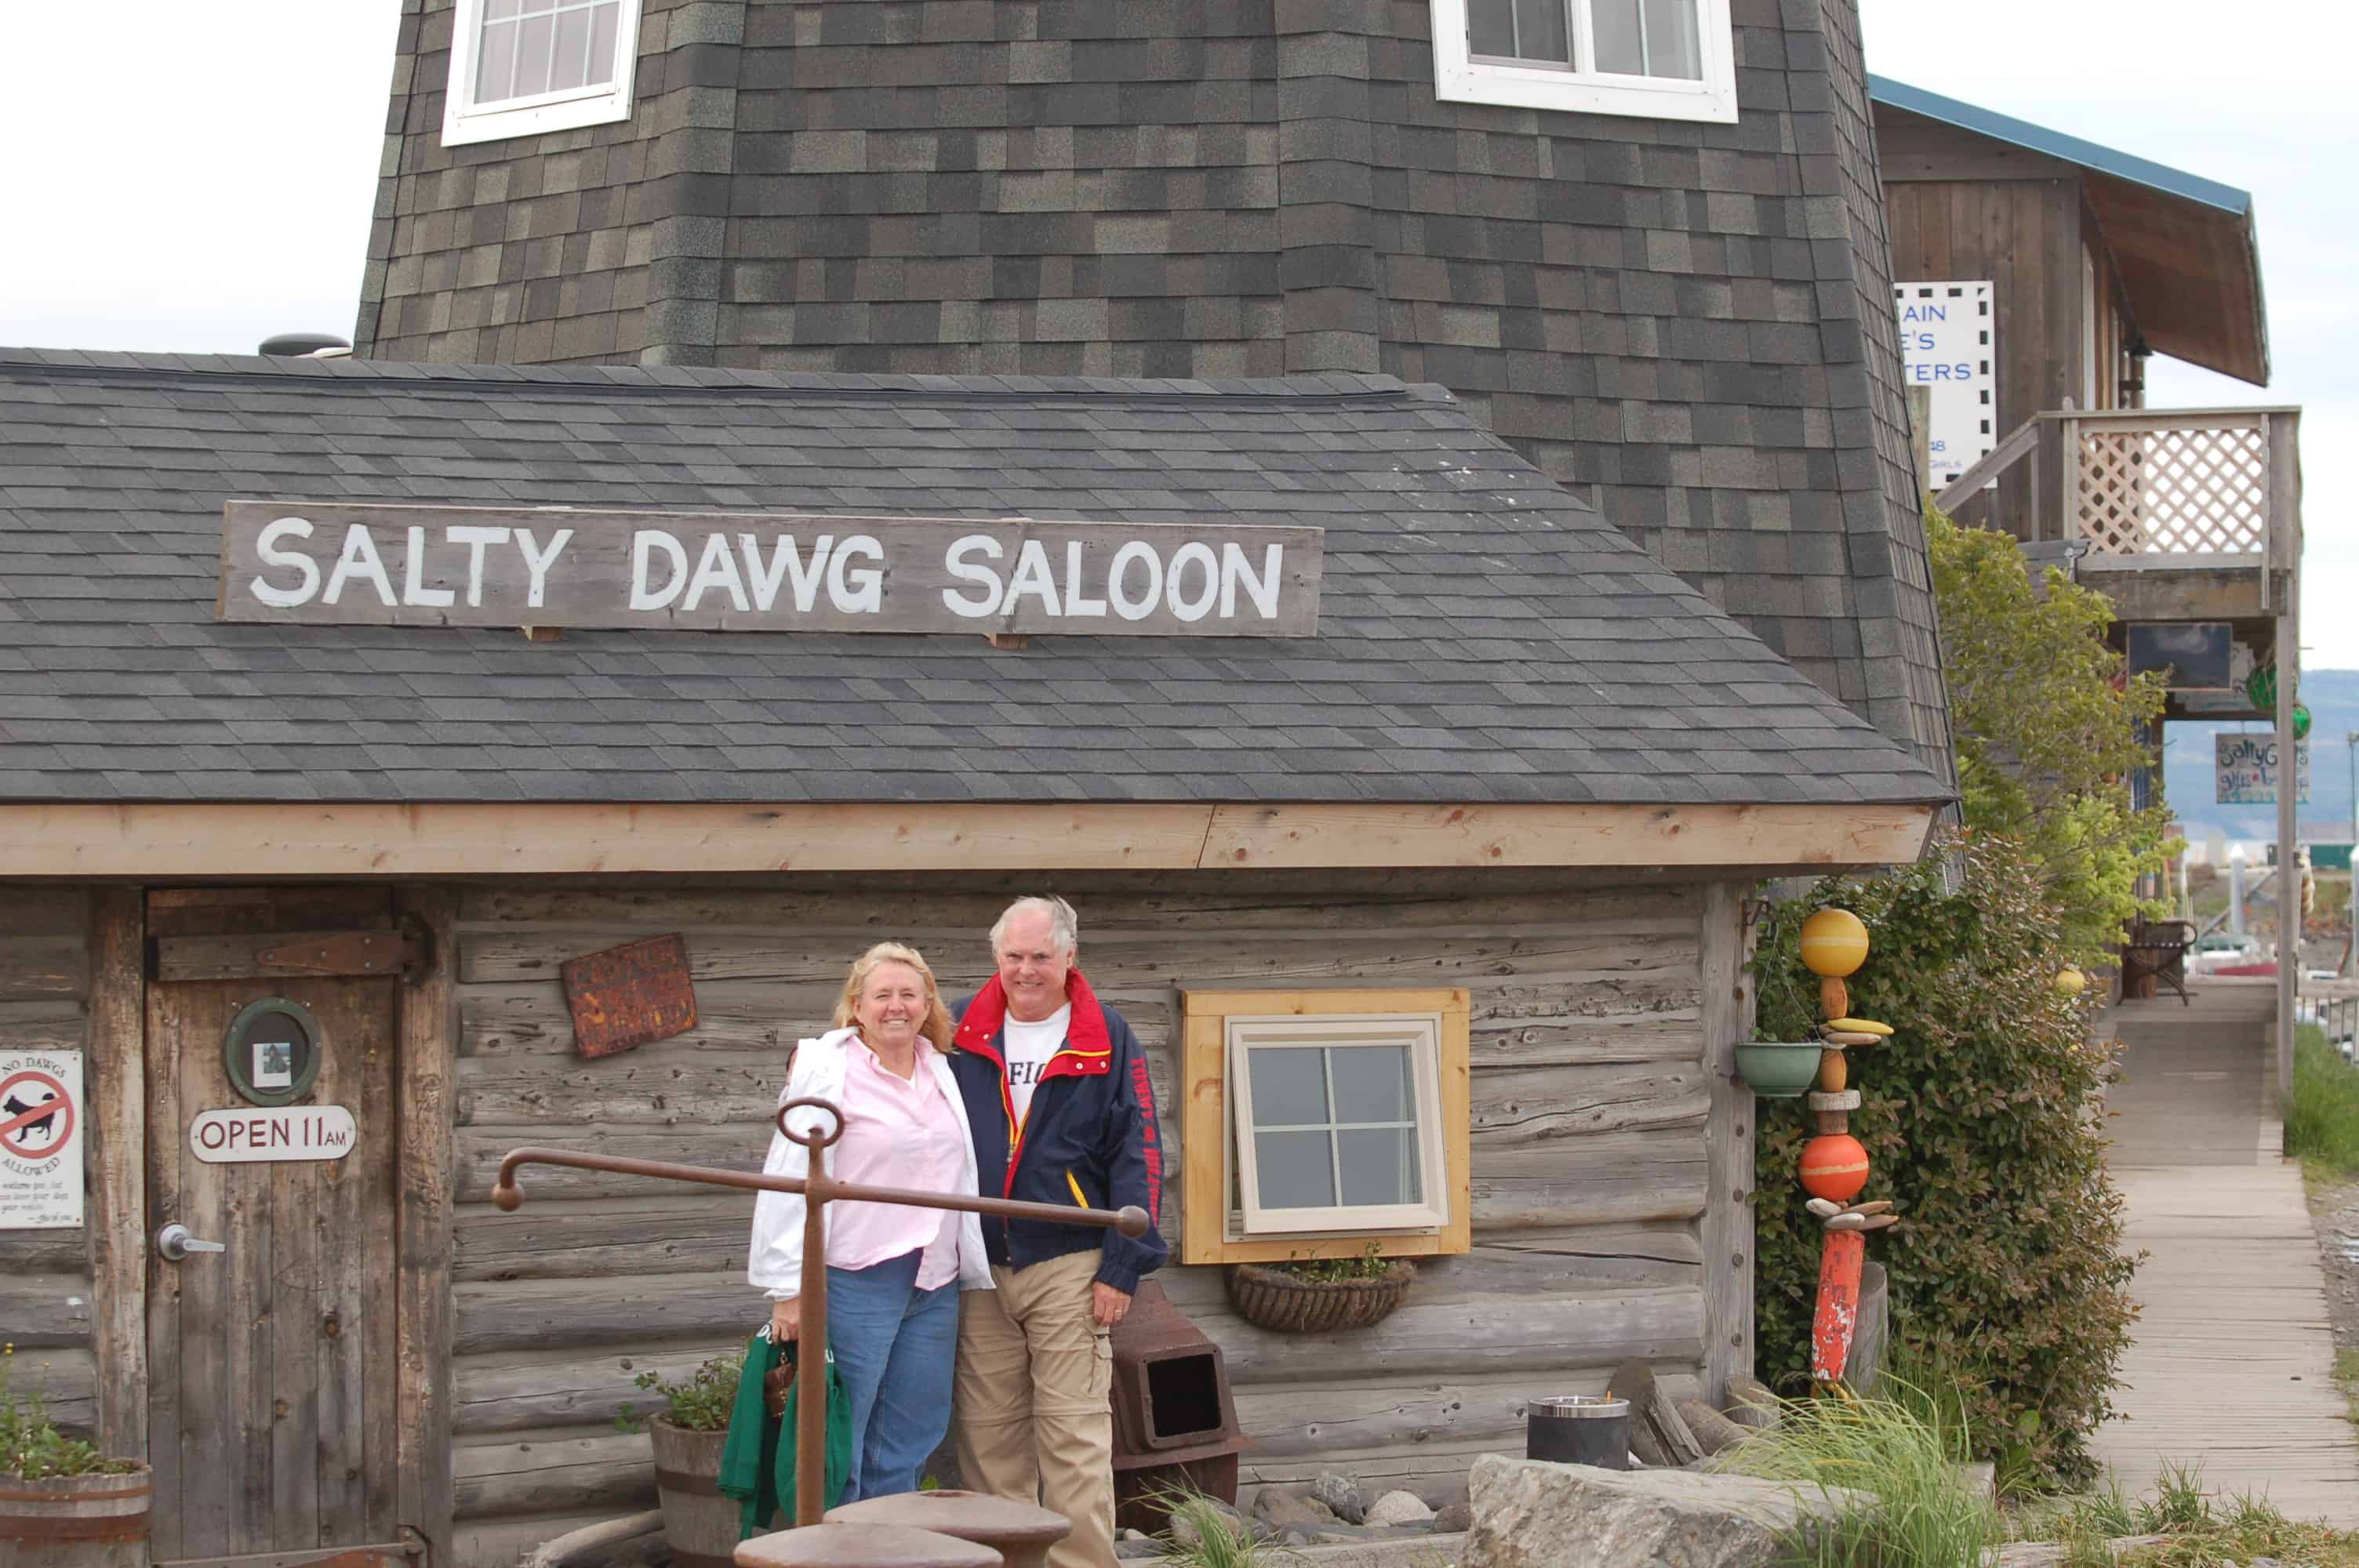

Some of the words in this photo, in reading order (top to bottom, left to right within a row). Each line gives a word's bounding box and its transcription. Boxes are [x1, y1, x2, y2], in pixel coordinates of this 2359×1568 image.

[1896, 304, 1946, 322] AIN
[249, 517, 574, 608] SALTY
[628, 530, 885, 614] DAWG
[942, 534, 1284, 622] SALOON
[2, 1058, 20, 1076] NO
[25, 1057, 67, 1079] DAWGS
[200, 1117, 290, 1149] OPEN
[2, 1156, 60, 1176] ALLOWED
